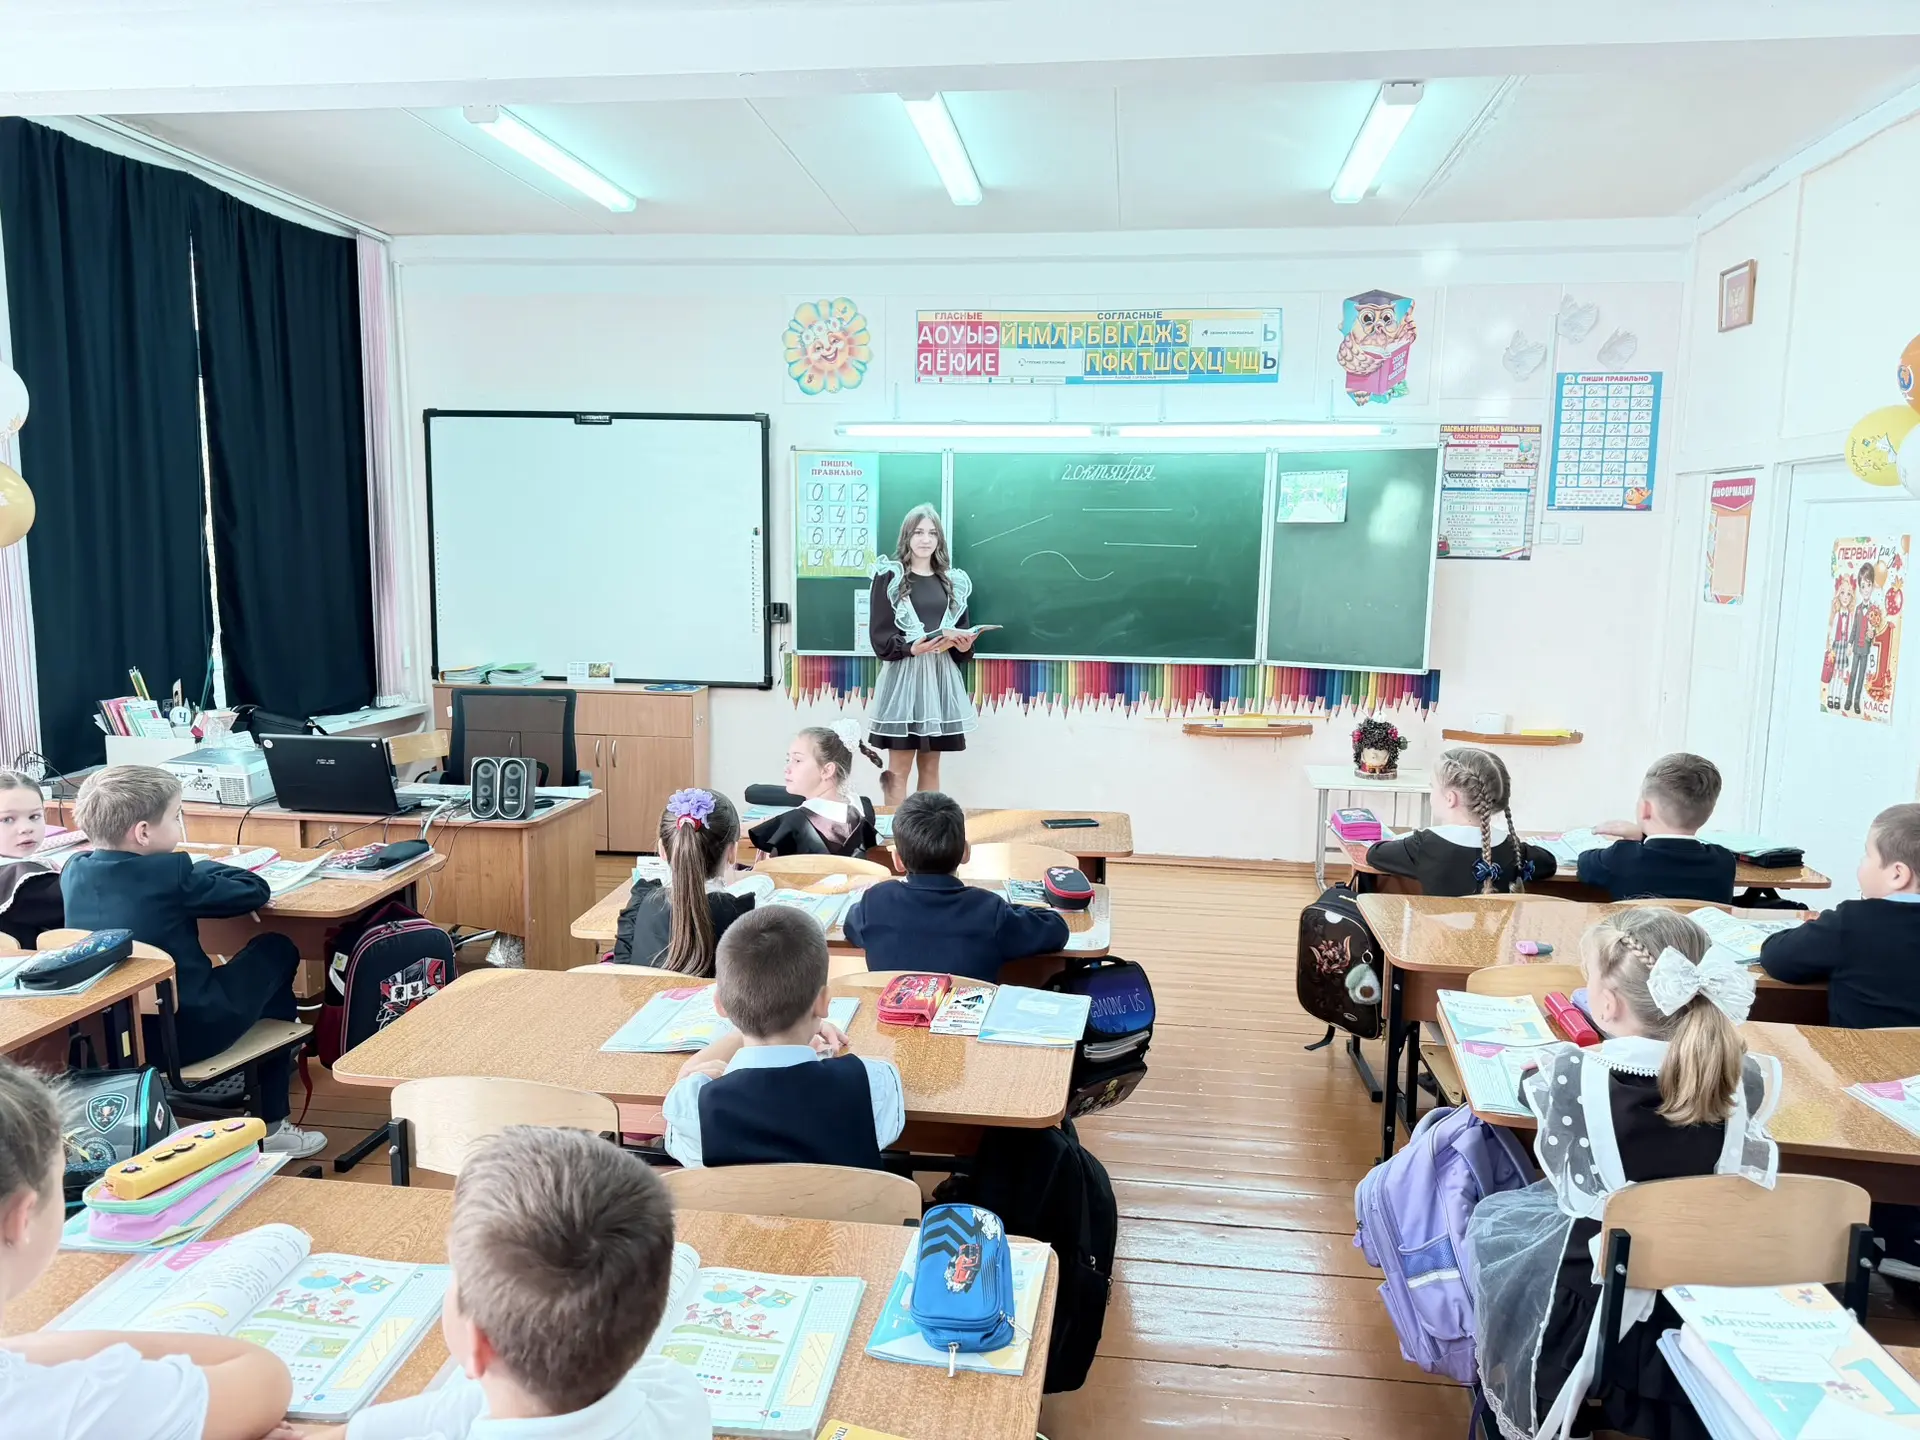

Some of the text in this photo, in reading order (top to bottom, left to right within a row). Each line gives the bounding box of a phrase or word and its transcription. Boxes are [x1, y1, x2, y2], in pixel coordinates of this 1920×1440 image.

[934, 312, 983, 320] ГЛАСНЫЕ
[1097, 310, 1163, 320] СОГЛАСНЫЕ
[812, 483, 868, 502] 0 1 2
[1712, 485, 1753, 498] ИНФОРМАЦИЯ
[811, 505, 868, 523] 3 4 5
[812, 527, 868, 545] 6 7 8
[813, 549, 823, 566] 9
[1838, 545, 1896, 569] ПЕРВЫЙ раз
[1875, 622, 1892, 689] 1
[1864, 700, 1889, 714] КЛАСС
[1128, 992, 1146, 1012] US
[1700, 1315, 1838, 1330] Математика
